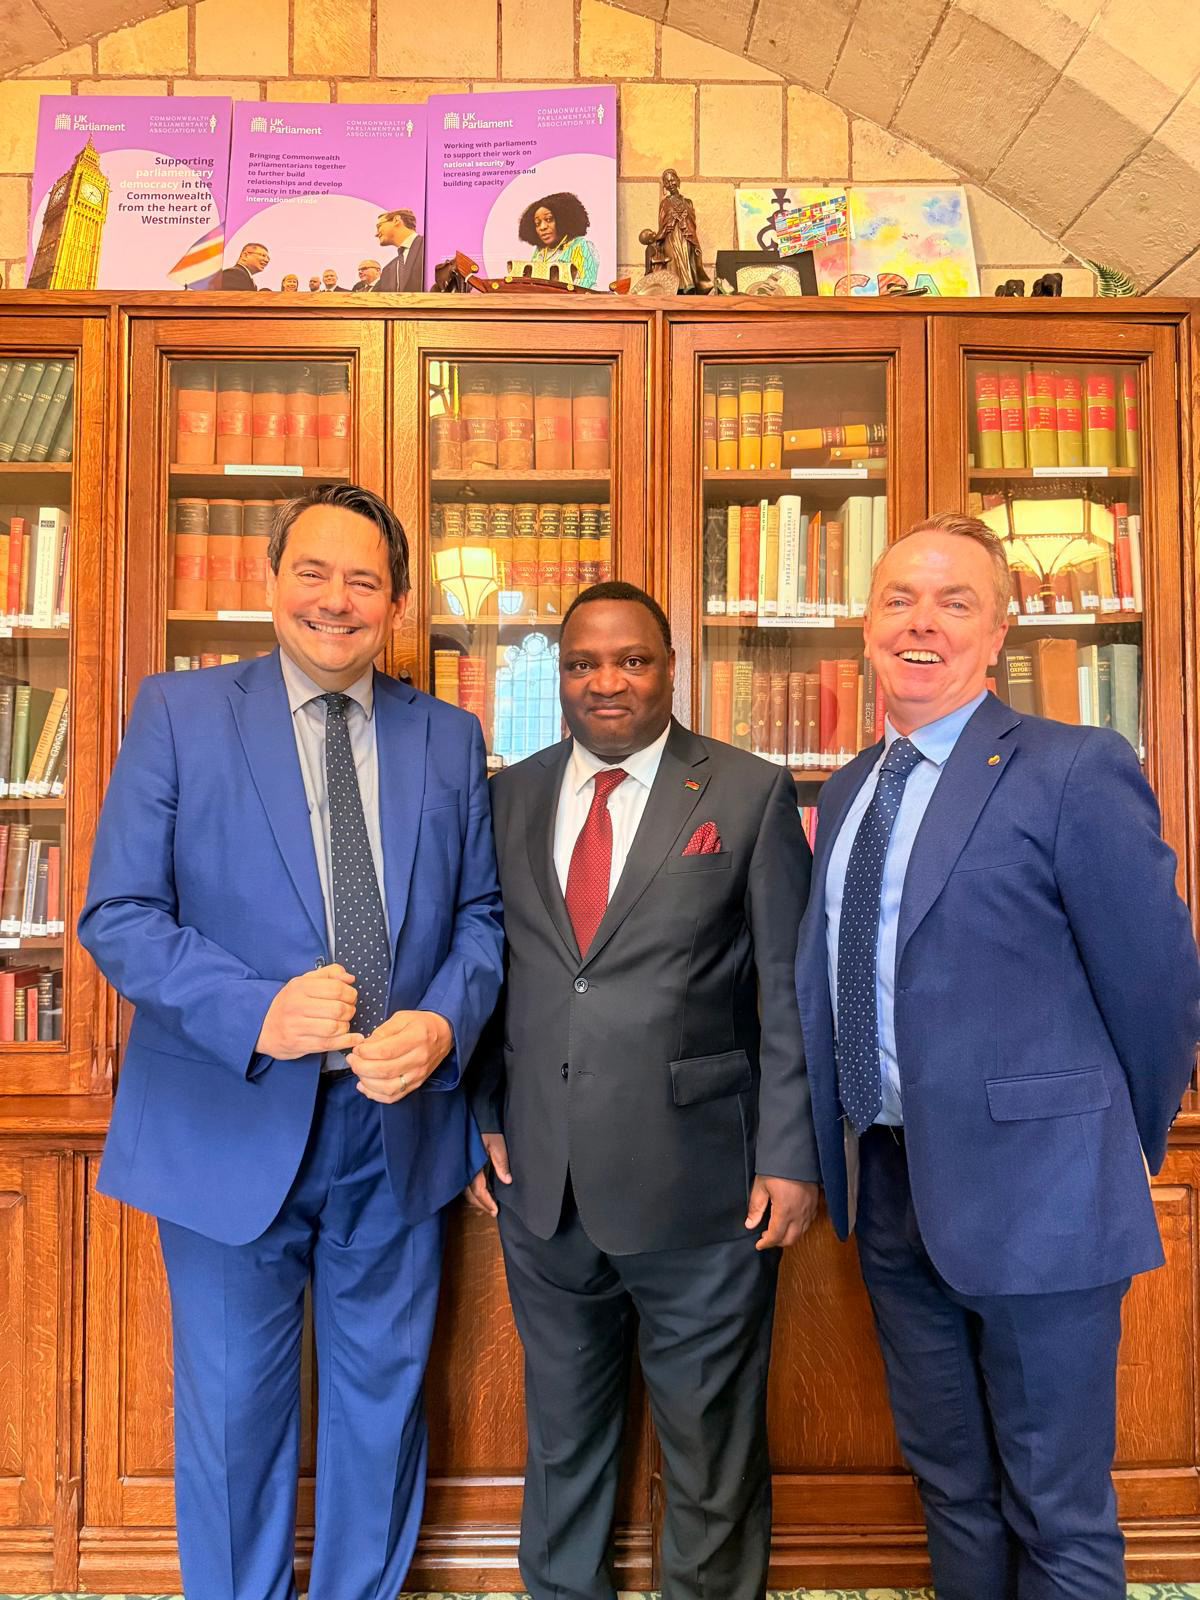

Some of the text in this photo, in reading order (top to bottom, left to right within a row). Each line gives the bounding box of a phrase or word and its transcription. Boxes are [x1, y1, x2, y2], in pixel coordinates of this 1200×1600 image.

[537, 105, 597, 115] COMMONWEALTH
[74, 114, 88, 123] UK
[462, 112, 476, 121] UK
[537, 113, 596, 121] PARLIAMENTARY
[270, 117, 284, 126] UK
[462, 119, 514, 129] Parliament
[537, 120, 585, 128] ASSOCIATION
[74, 122, 126, 131] Parliament
[269, 125, 323, 135] Parliament
[493, 140, 538, 149] parliaments
[249, 152, 341, 161] Bringing Commonwealth
[453, 151, 482, 159] support
[155, 157, 214, 167] Supporting
[248, 161, 347, 171] parliamentarians together
[443, 159, 515, 169] national security by
[136, 168, 214, 179] parliamentary
[257, 169, 284, 177] further
[443, 170, 481, 178] increasing
[482, 168, 521, 176] awareness
[119, 179, 213, 190] democracy in the
[247, 178, 296, 187] relationships
[443, 178, 505, 187] building capacity
[126, 191, 212, 200] Commonwealth
[246, 187, 279, 196] capacity
[118, 203, 213, 212] from the heart of
[141, 215, 211, 225] Westminster
